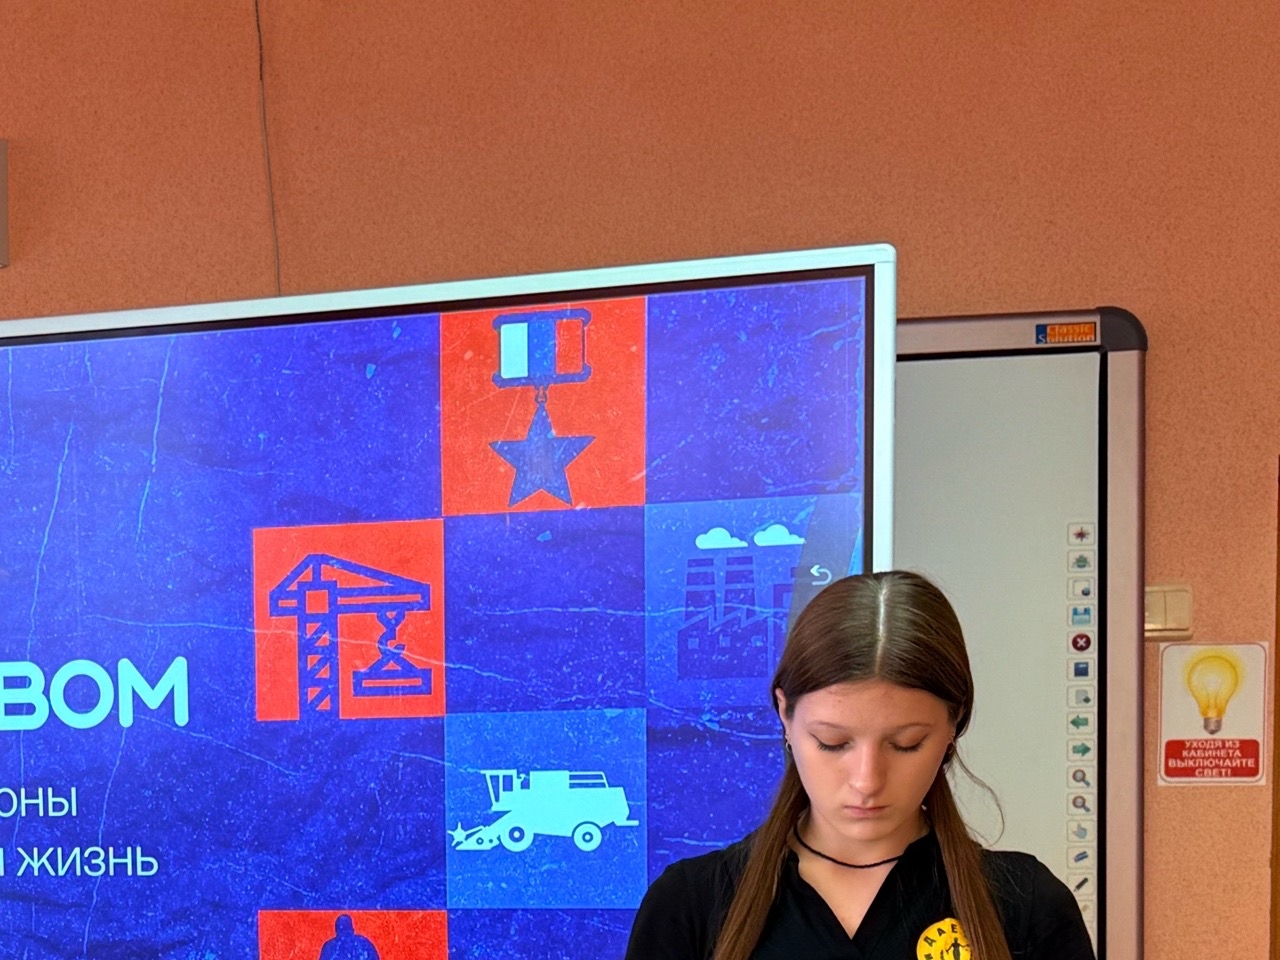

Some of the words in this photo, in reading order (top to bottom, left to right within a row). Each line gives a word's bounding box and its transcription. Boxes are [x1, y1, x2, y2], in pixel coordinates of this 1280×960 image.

[1184, 740, 1223, 749] УХОДЯ
[1225, 740, 1240, 748] ИЗ
[1182, 749, 1242, 758] КАБИНЕТА
[1168, 757, 1256, 768] ВЫКЛЮЧАЙТЕ
[17, 845, 159, 878] жизнь
[923, 923, 958, 947] ДАЕ
